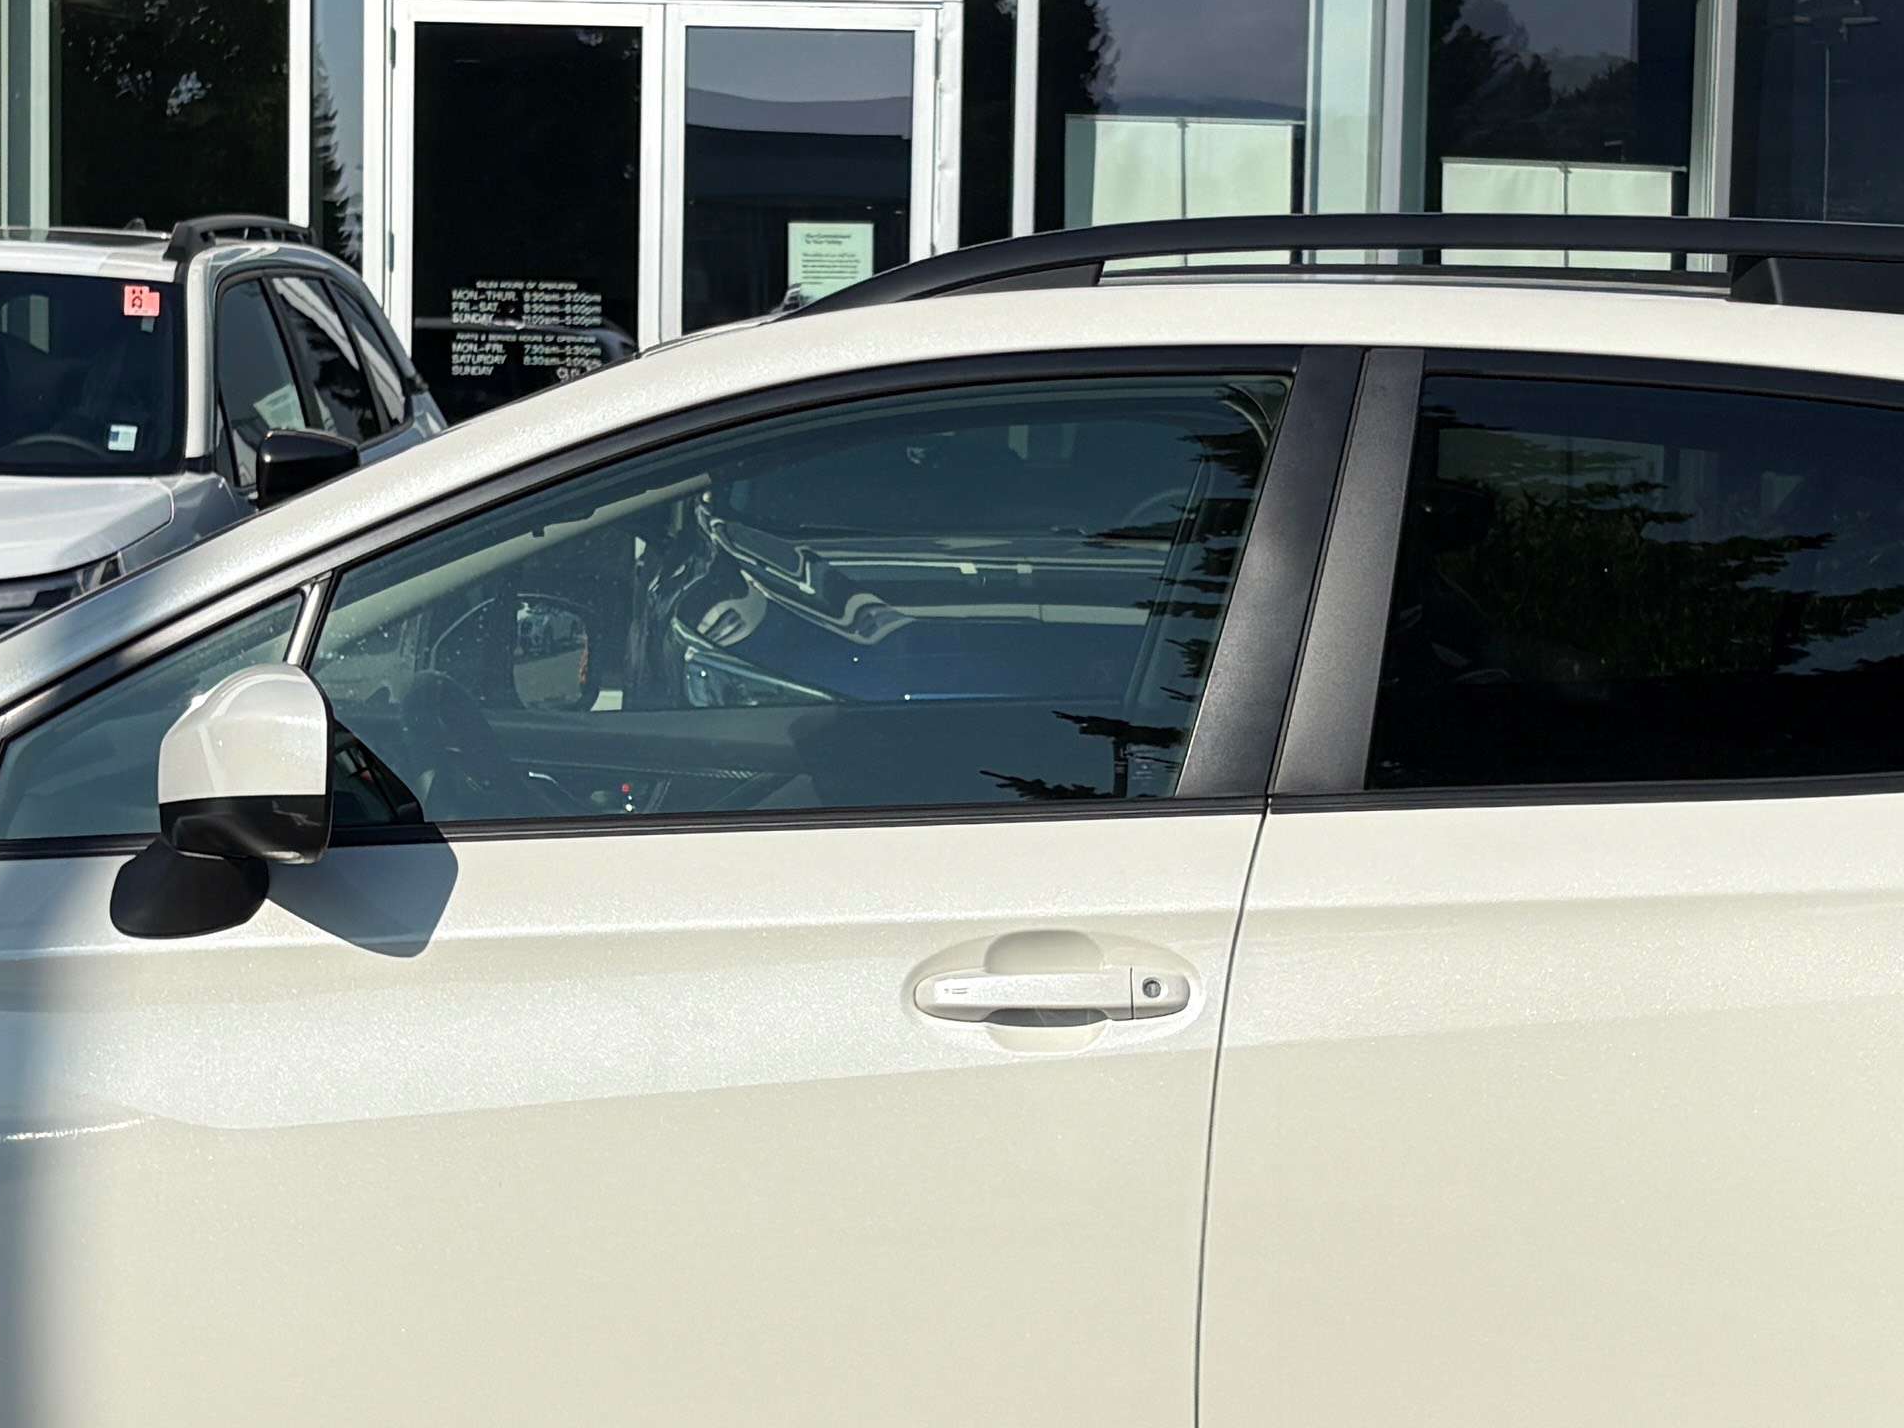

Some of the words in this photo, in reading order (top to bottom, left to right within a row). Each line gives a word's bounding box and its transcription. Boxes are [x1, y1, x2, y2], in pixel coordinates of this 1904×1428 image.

[452, 313, 494, 324] SUNDAY
[452, 354, 507, 364] SATURDAY
[452, 366, 494, 376] SUNDAY
